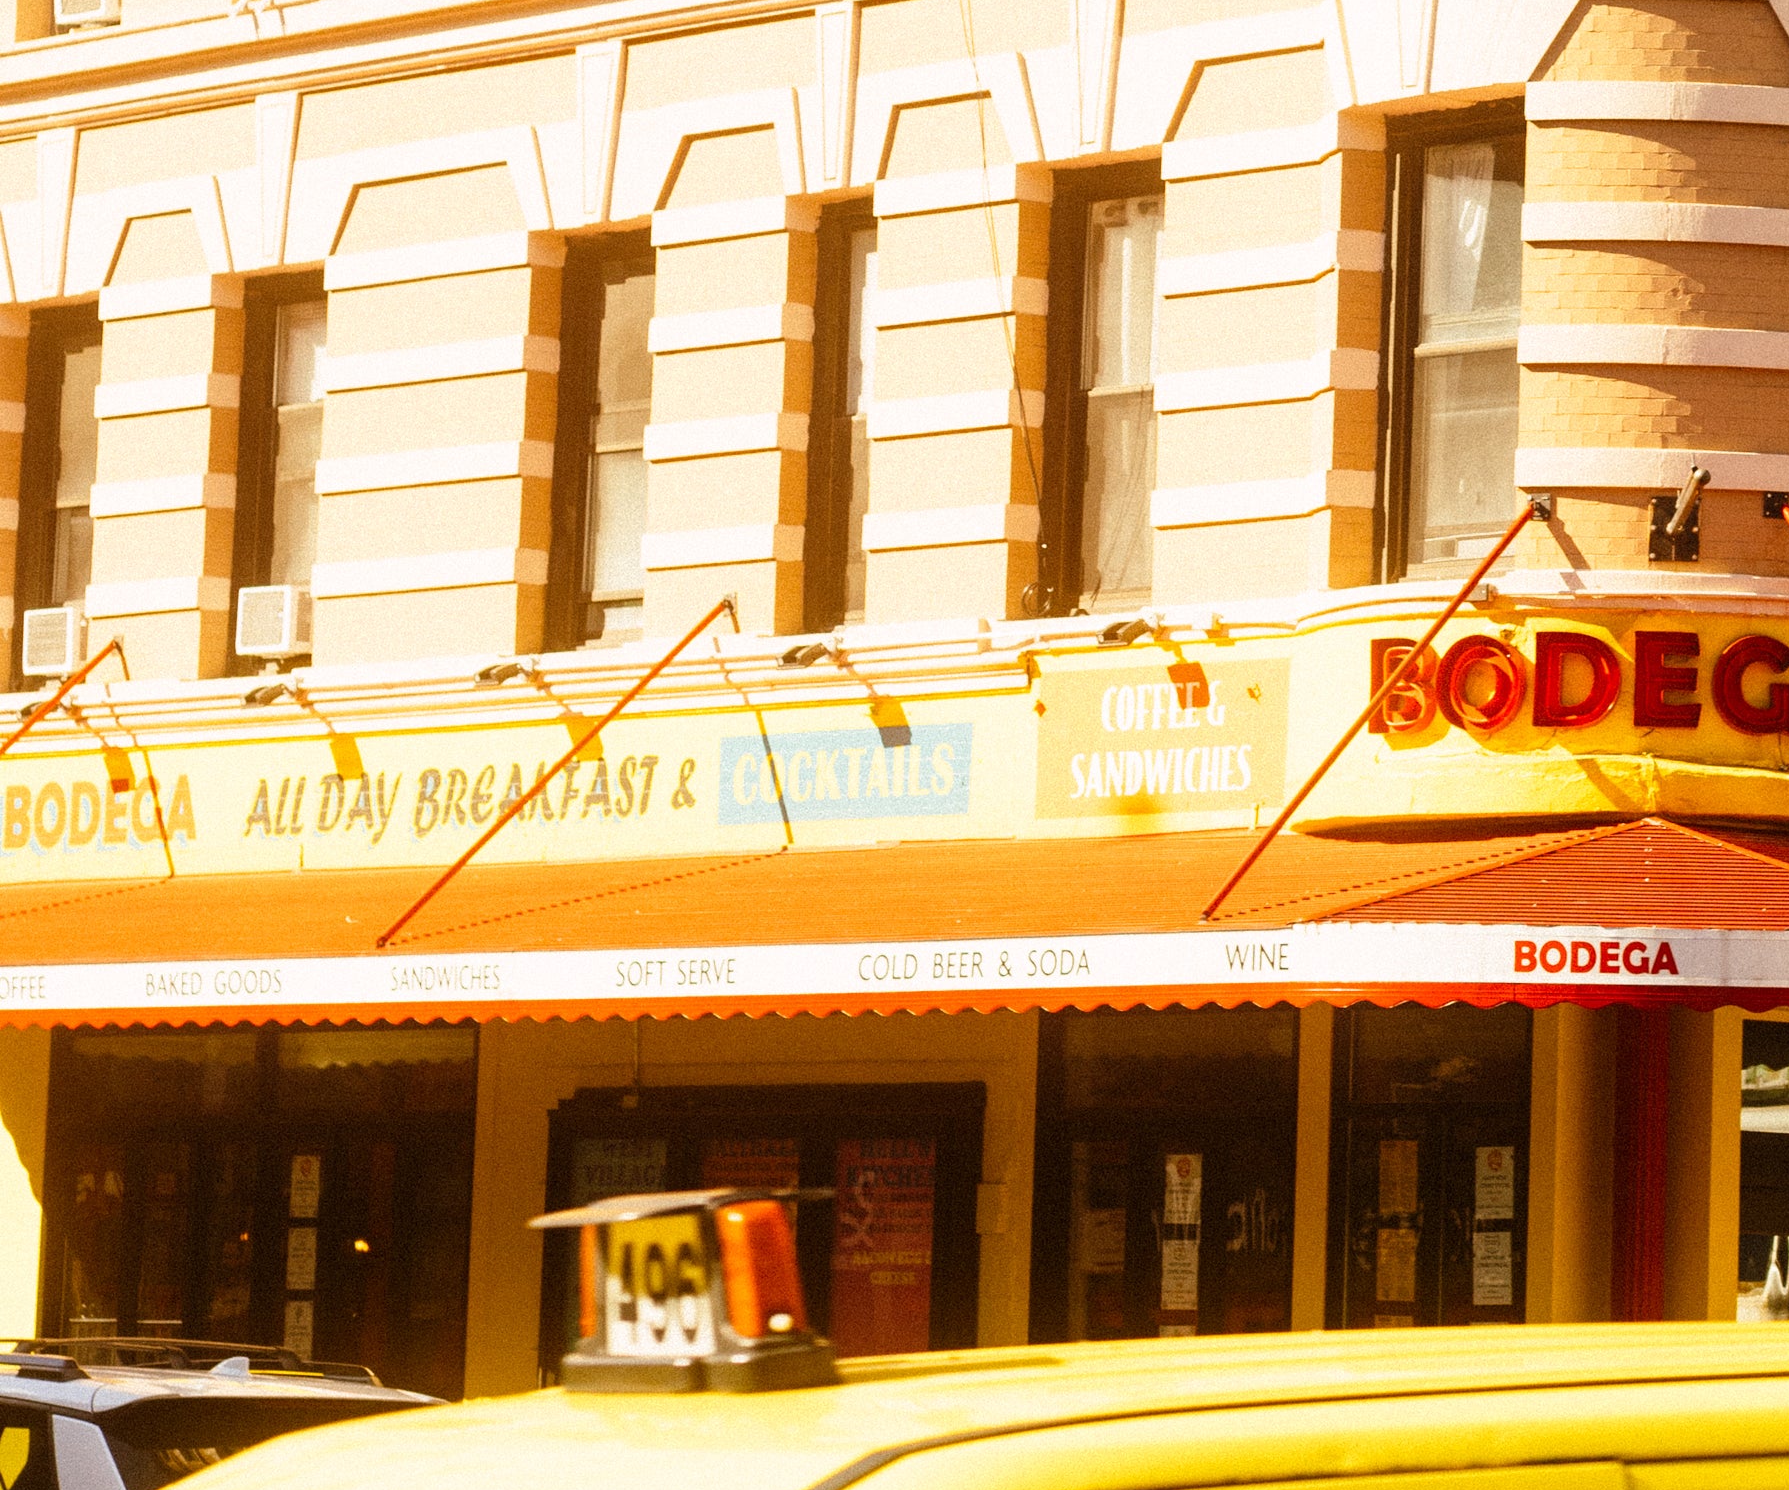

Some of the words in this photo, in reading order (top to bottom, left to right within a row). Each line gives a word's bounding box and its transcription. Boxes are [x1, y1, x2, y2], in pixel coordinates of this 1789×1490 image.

[1100, 682, 1200, 733] COFFEE
[732, 742, 955, 806] COCKTAILS
[1070, 744, 1252, 800] SANDWICHES
[3, 774, 197, 850] BODEGA
[243, 776, 303, 839] ALL
[319, 770, 402, 845] DAY
[415, 755, 659, 837] BREAKFAST
[671, 756, 696, 810] &
[616, 962, 665, 988] SOFT
[677, 959, 737, 986] SERVE
[858, 953, 918, 983] COLD
[932, 951, 983, 980] BEER
[998, 950, 1013, 977] &
[1028, 949, 1091, 977] SODA
[1226, 943, 1290, 973] WINE
[1513, 940, 1679, 976] BODEGA
[0, 974, 46, 1000] OFFEE
[145, 971, 202, 997] BAKED
[214, 969, 282, 996] GOODS
[390, 966, 501, 993] SANDWICHES
